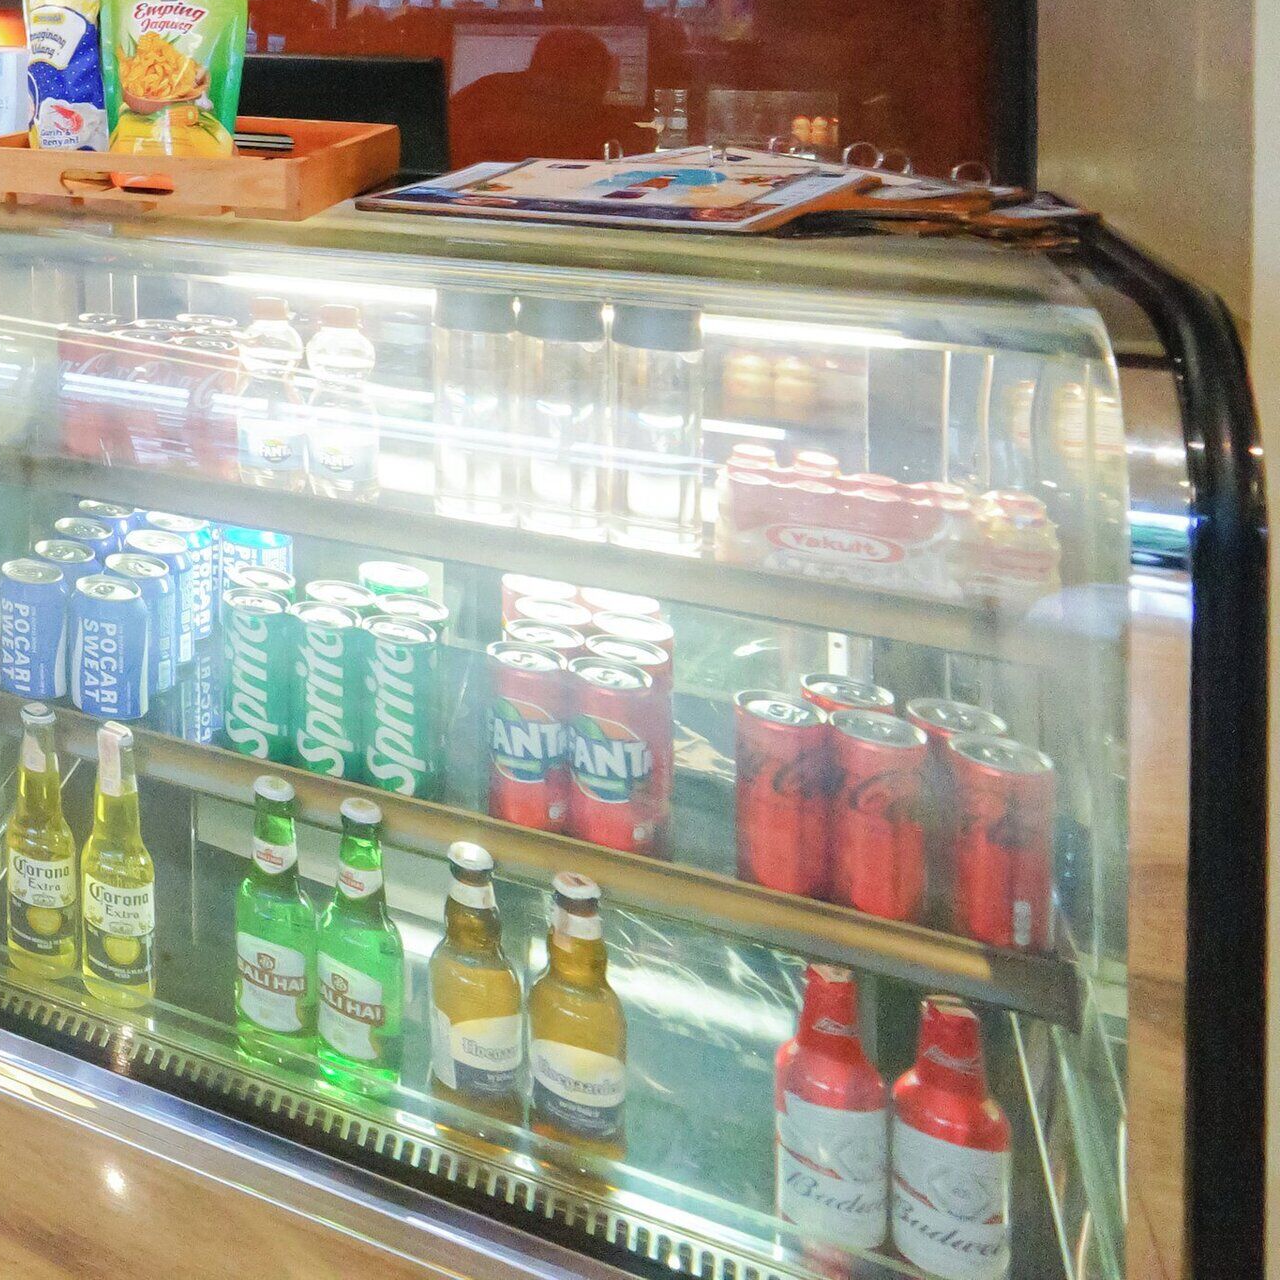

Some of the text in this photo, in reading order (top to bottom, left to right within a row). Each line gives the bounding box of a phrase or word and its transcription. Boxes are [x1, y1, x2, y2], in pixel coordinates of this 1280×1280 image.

[133, 1, 208, 21] Emping
[140, 17, 194, 35] Jagung
[791, 531, 880, 557] Yakult
[1, 597, 15, 680] SWEAT
[13, 602, 31, 692] POCARI
[83, 618, 100, 703] SWEAT
[99, 622, 119, 714] POCARI
[224, 610, 279, 760] Sprite
[296, 625, 354, 778] Sprite
[365, 639, 427, 797] Sprite
[13, 855, 70, 879] Corona
[28, 878, 61, 892] Extra
[89, 881, 149, 907] Corona
[105, 904, 140, 919] Extra
[273, 975, 305, 992] HAI
[347, 997, 381, 1019] HAI
